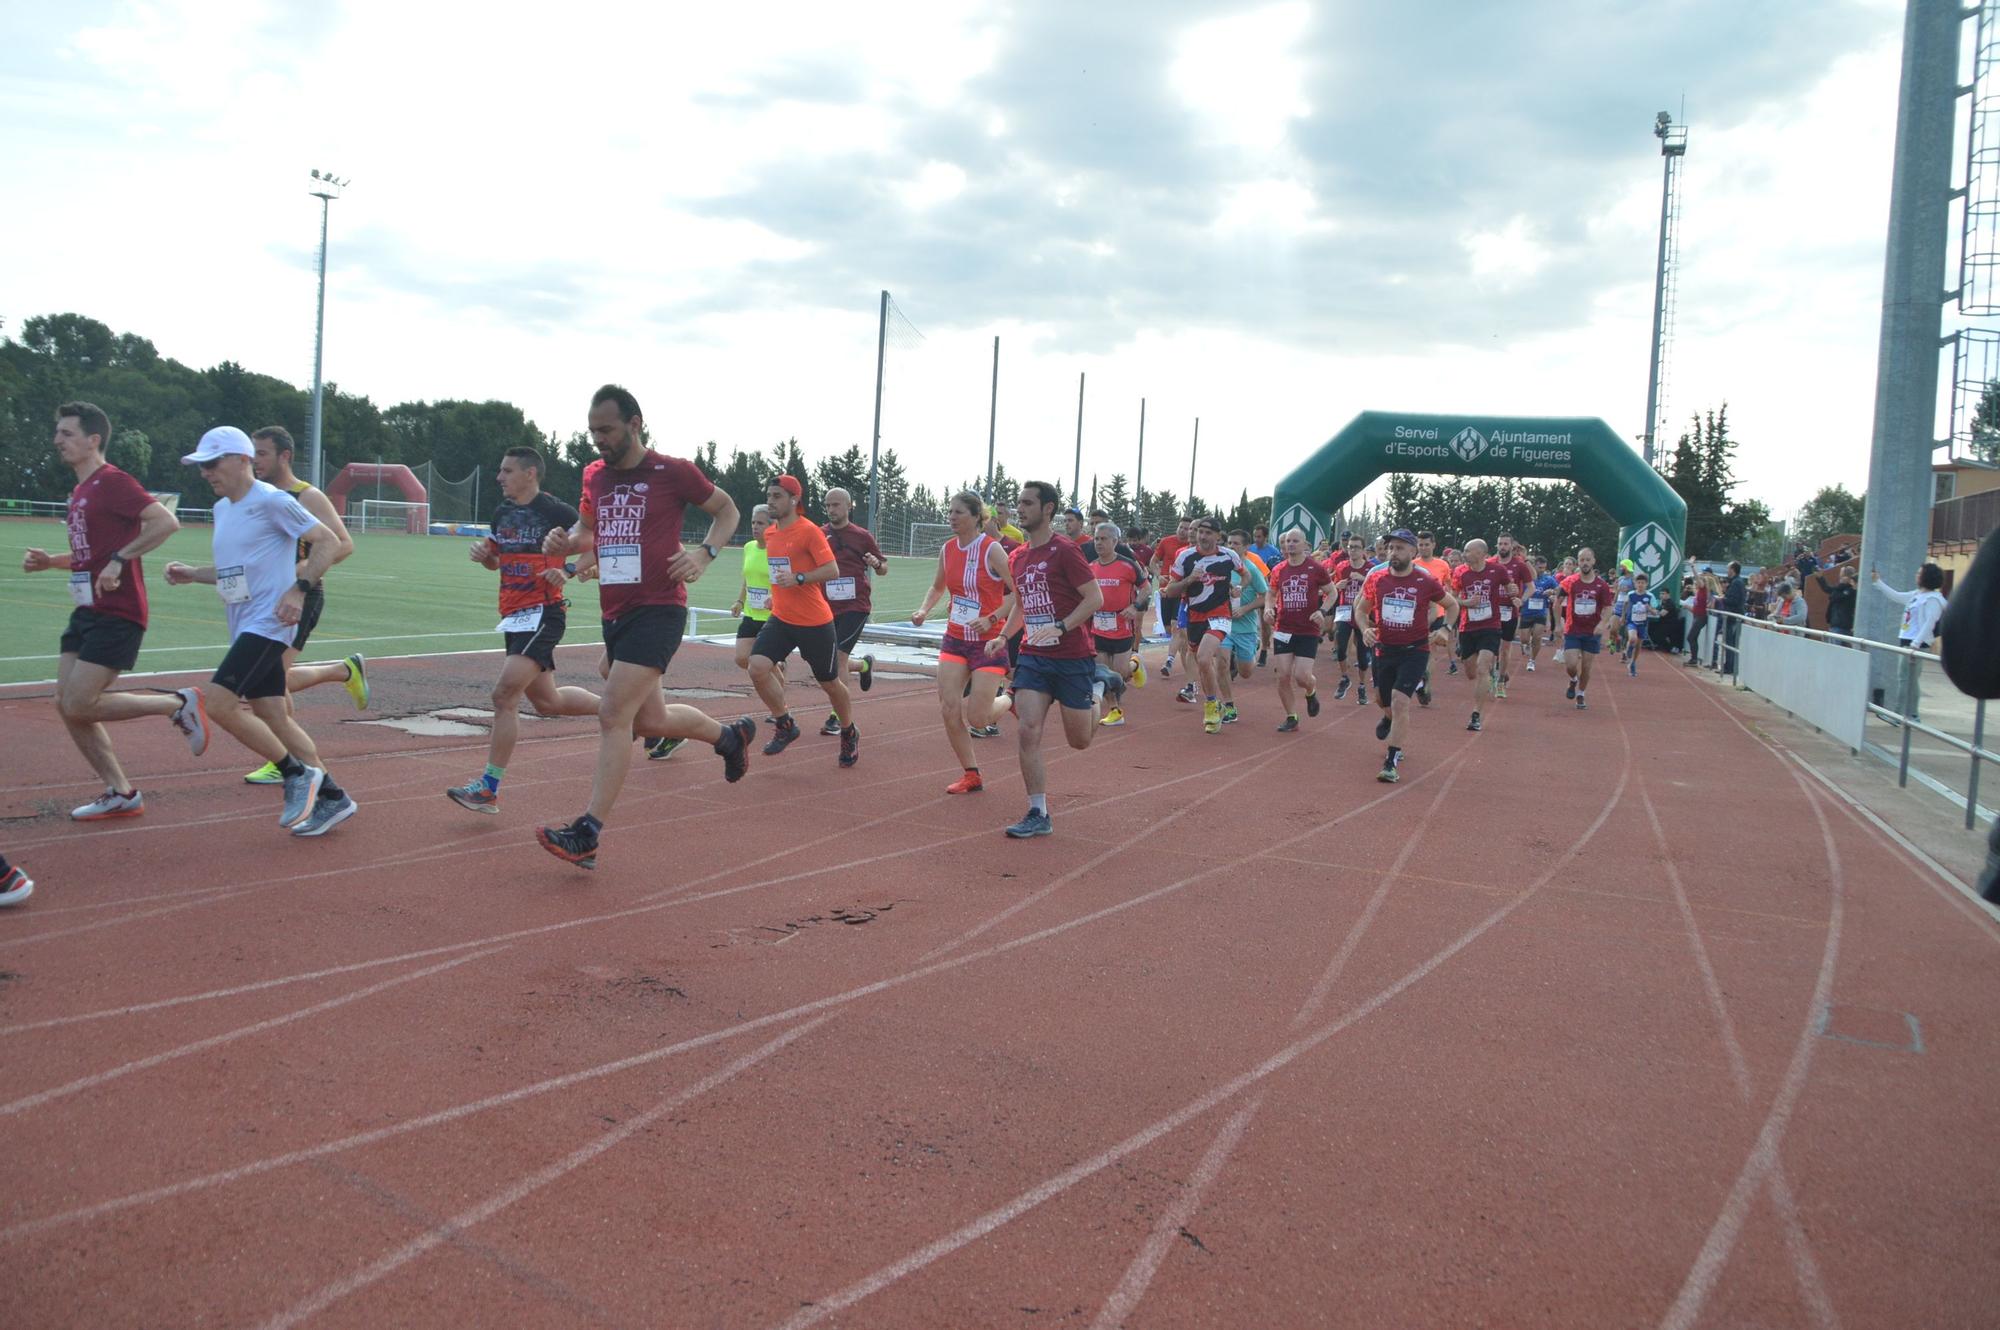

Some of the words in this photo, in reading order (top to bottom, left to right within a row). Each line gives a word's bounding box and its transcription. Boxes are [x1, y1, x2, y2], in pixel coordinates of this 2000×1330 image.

[1394, 425, 1438, 440] Servei
[1490, 430, 1572, 445] Ajuntament
[1385, 442, 1449, 458] d'Esports
[1490, 446, 1508, 457] de
[1512, 447, 1571, 462] Figueres
[613, 494, 629, 506] XV
[599, 508, 641, 518] RUN
[598, 520, 641, 536] CASTELL
[612, 557, 618, 569] 2
[1019, 583, 1046, 594] RUN
[1283, 593, 1307, 602] CASTELL
[959, 605, 968, 616] 58
